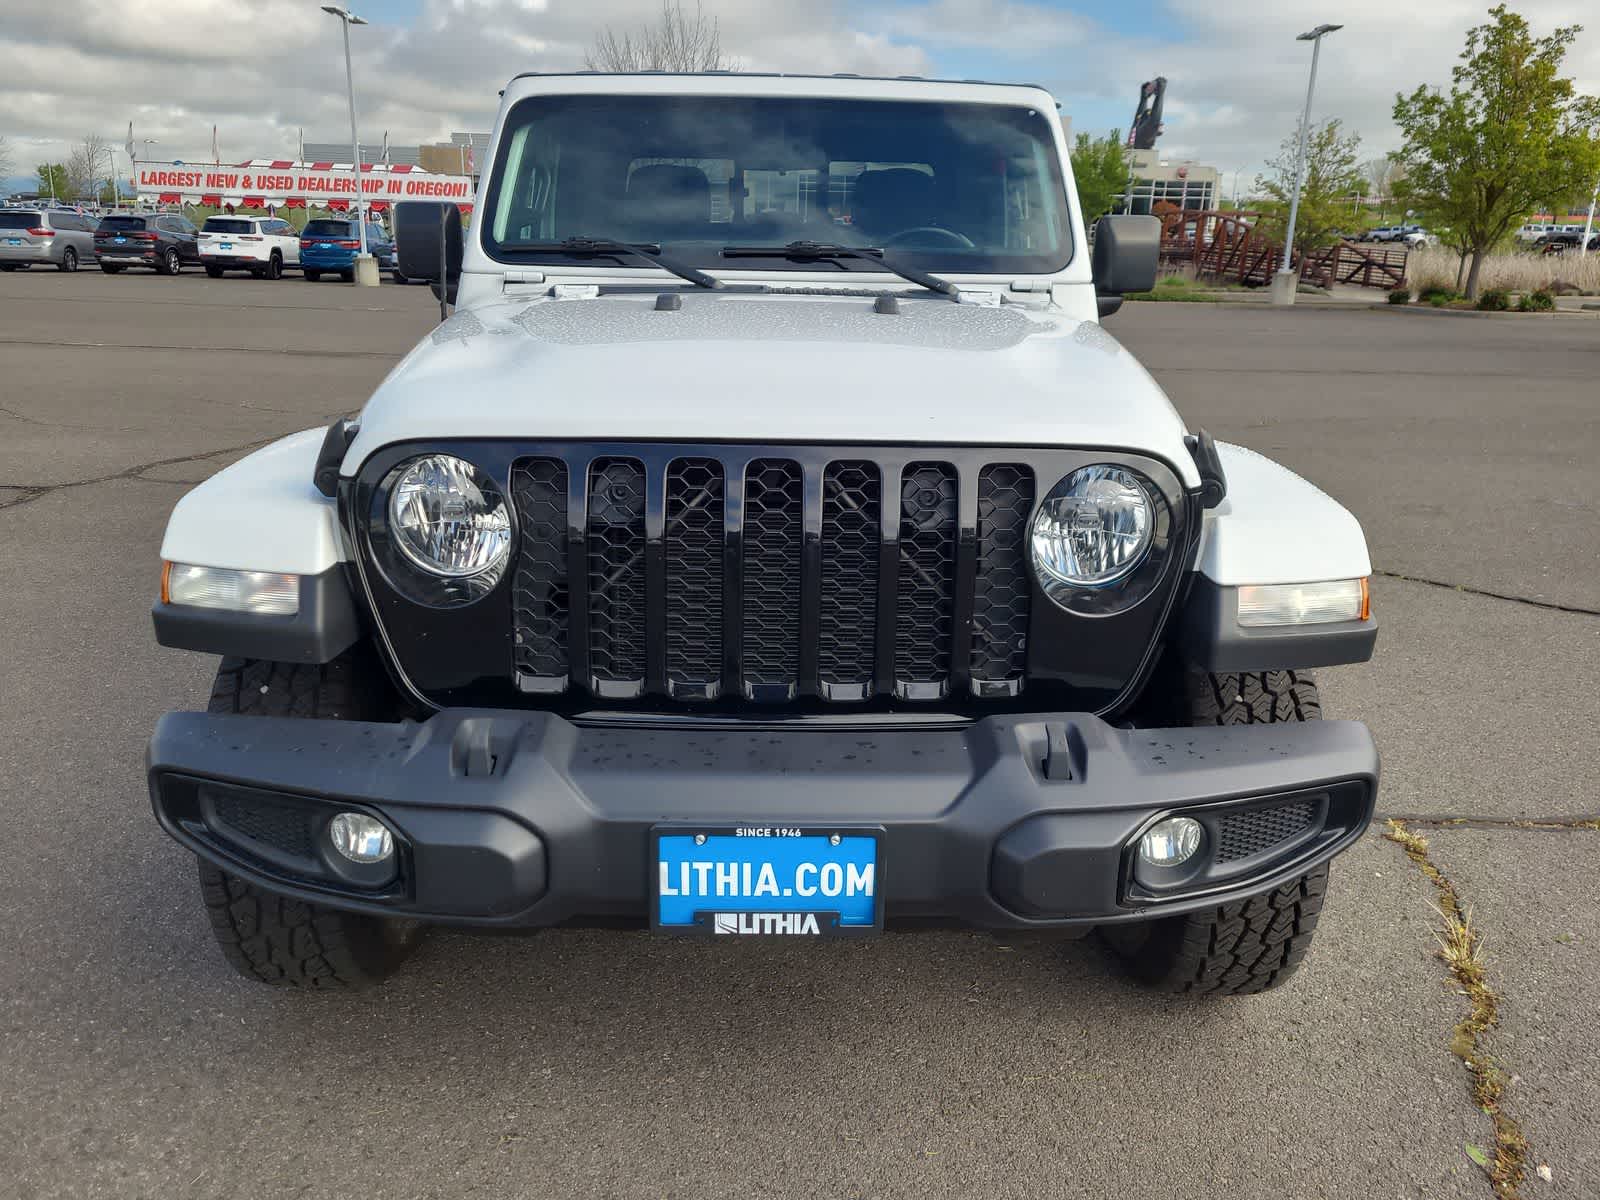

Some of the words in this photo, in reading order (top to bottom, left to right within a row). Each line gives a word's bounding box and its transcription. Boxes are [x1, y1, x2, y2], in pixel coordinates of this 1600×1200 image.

[141, 171, 202, 188] LARGEST
[206, 174, 239, 188] NEW
[242, 176, 253, 189] &
[257, 176, 294, 190] USED
[297, 176, 385, 193] DEALERSHIP
[387, 180, 401, 193] IN
[406, 181, 468, 196] OREGON!
[735, 828, 771, 837] SINCE
[775, 828, 802, 837] 1946
[659, 861, 875, 897] LITHIA.COM
[737, 913, 820, 934] LITHIA
